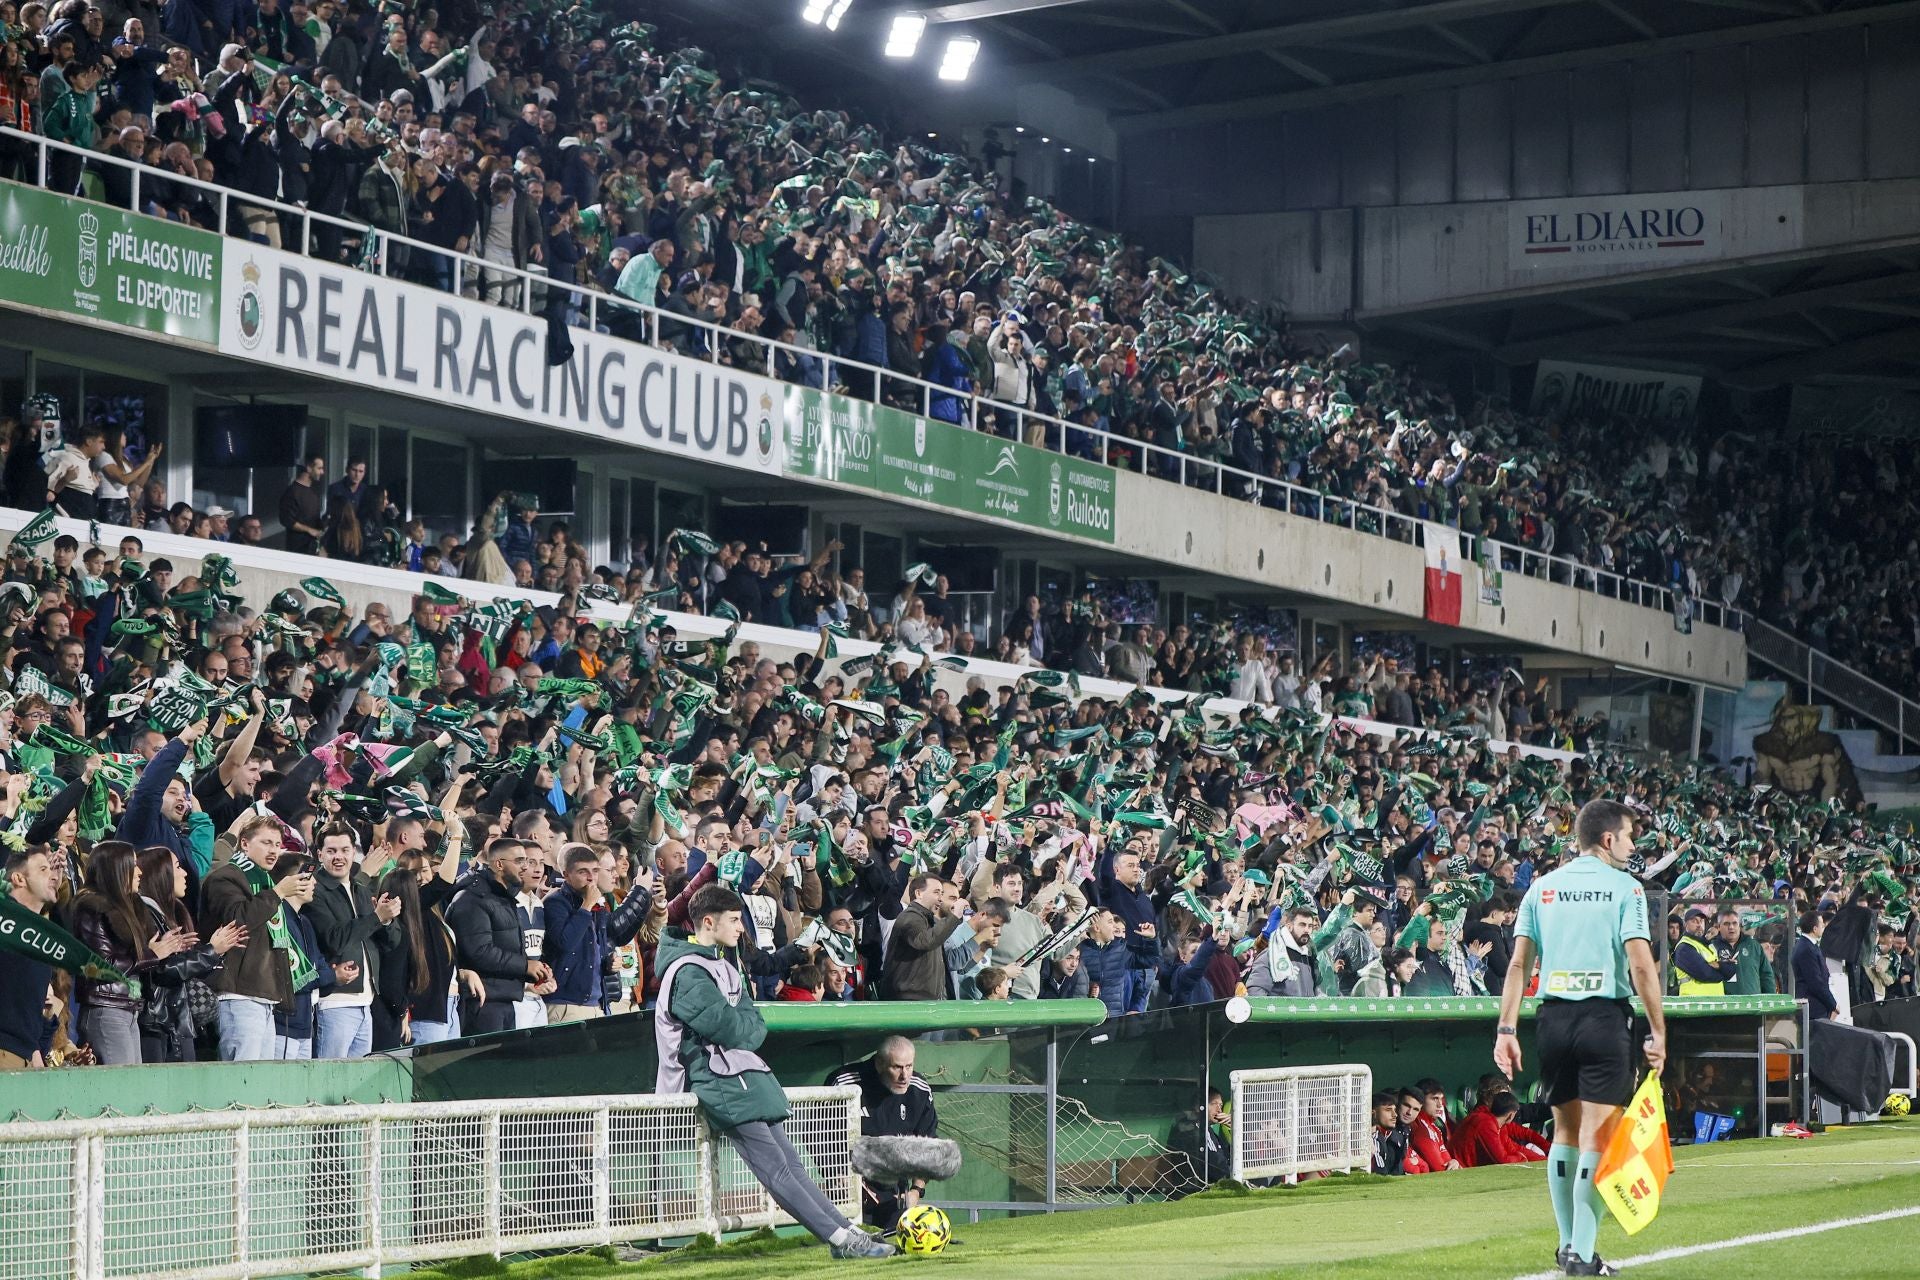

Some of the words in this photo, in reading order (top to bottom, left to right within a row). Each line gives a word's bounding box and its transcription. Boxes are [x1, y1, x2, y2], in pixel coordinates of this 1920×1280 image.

[1526, 215, 1570, 243] EL
[1575, 207, 1704, 242] DIARIO
[107, 226, 179, 273] ¡PIÉLAGOS
[182, 248, 213, 280] VIVE
[117, 274, 134, 305] EL
[136, 278, 200, 319] DEPORTE!
[276, 264, 418, 384] REAL
[433, 303, 626, 430] RACING
[638, 361, 749, 457] CLUB
[807, 422, 870, 460] POANCO
[1067, 488, 1110, 530] Ruiloba
[20, 517, 58, 540] RACIN
[1558, 891, 1613, 902] WÜRTH
[20, 927, 66, 961] CLUB
[1549, 972, 1604, 992] BKT
